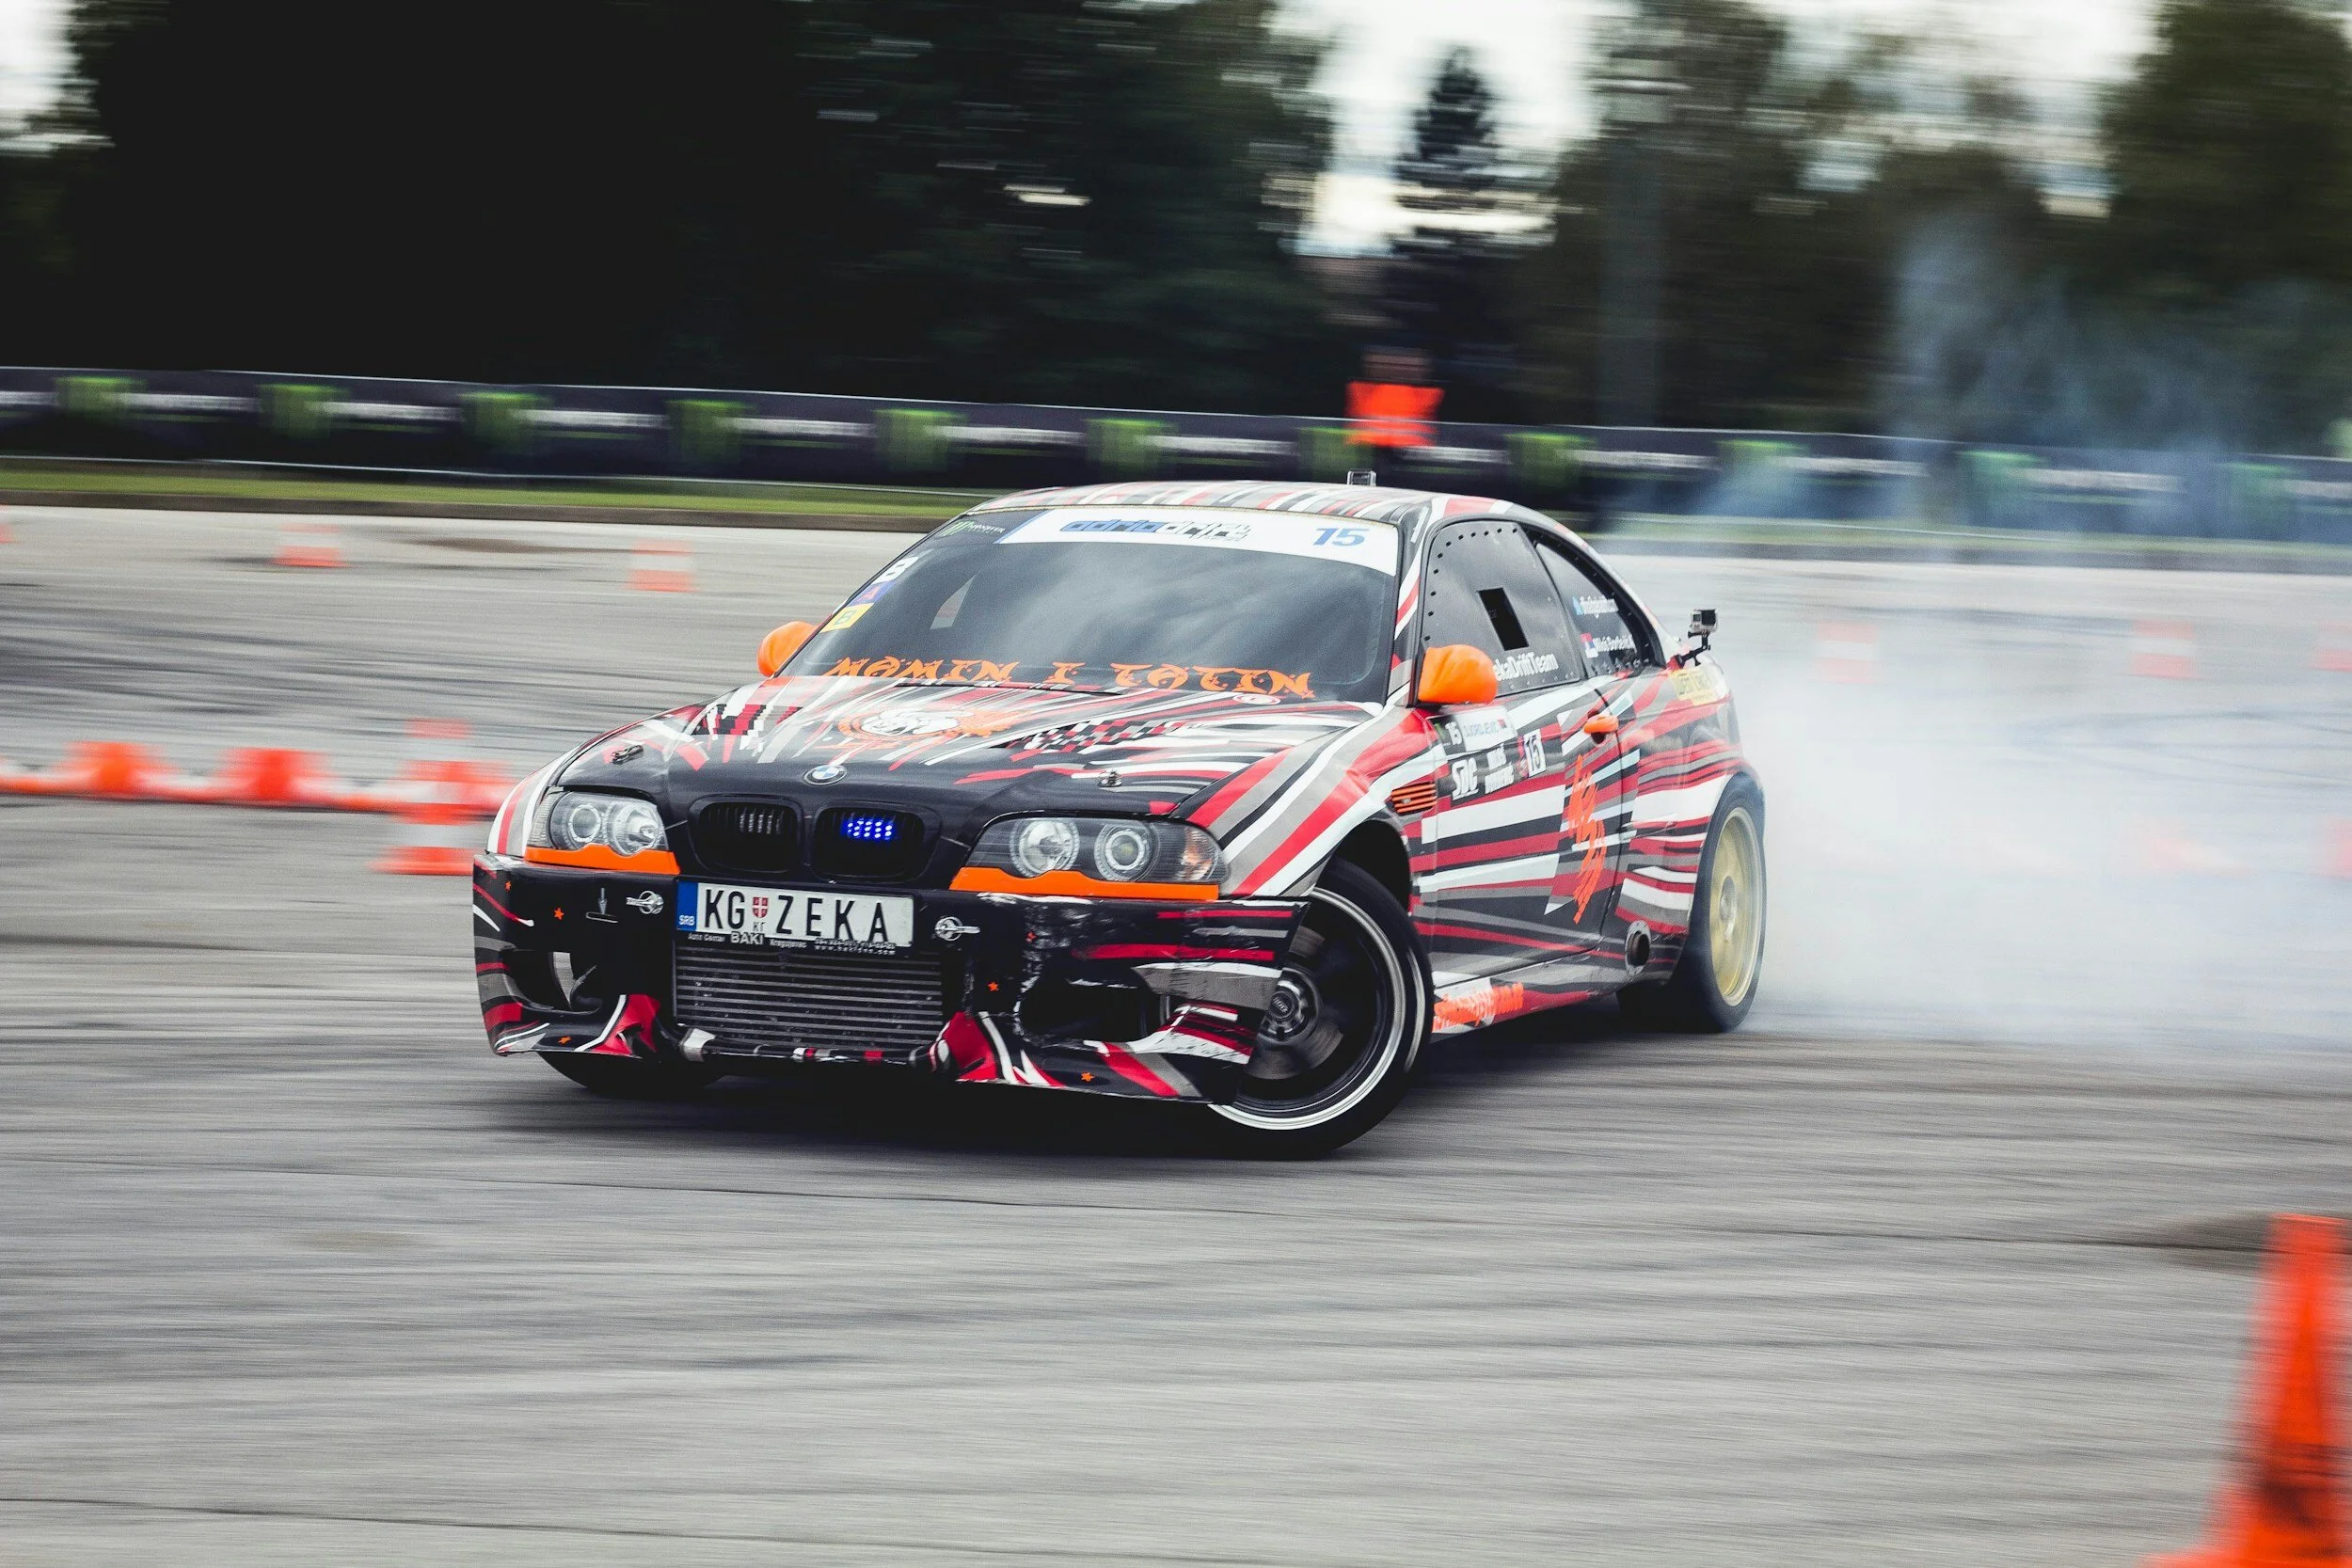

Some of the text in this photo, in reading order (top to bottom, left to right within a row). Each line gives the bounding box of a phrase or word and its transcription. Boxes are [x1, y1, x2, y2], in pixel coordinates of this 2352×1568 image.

[1313, 528, 1370, 546] 15
[1492, 651, 1559, 681] ekaDriftTeam
[1525, 735, 1543, 771] 15
[678, 915, 695, 926] SRB
[704, 889, 888, 942] KG ZEKA
[730, 930, 765, 945] BAKI
